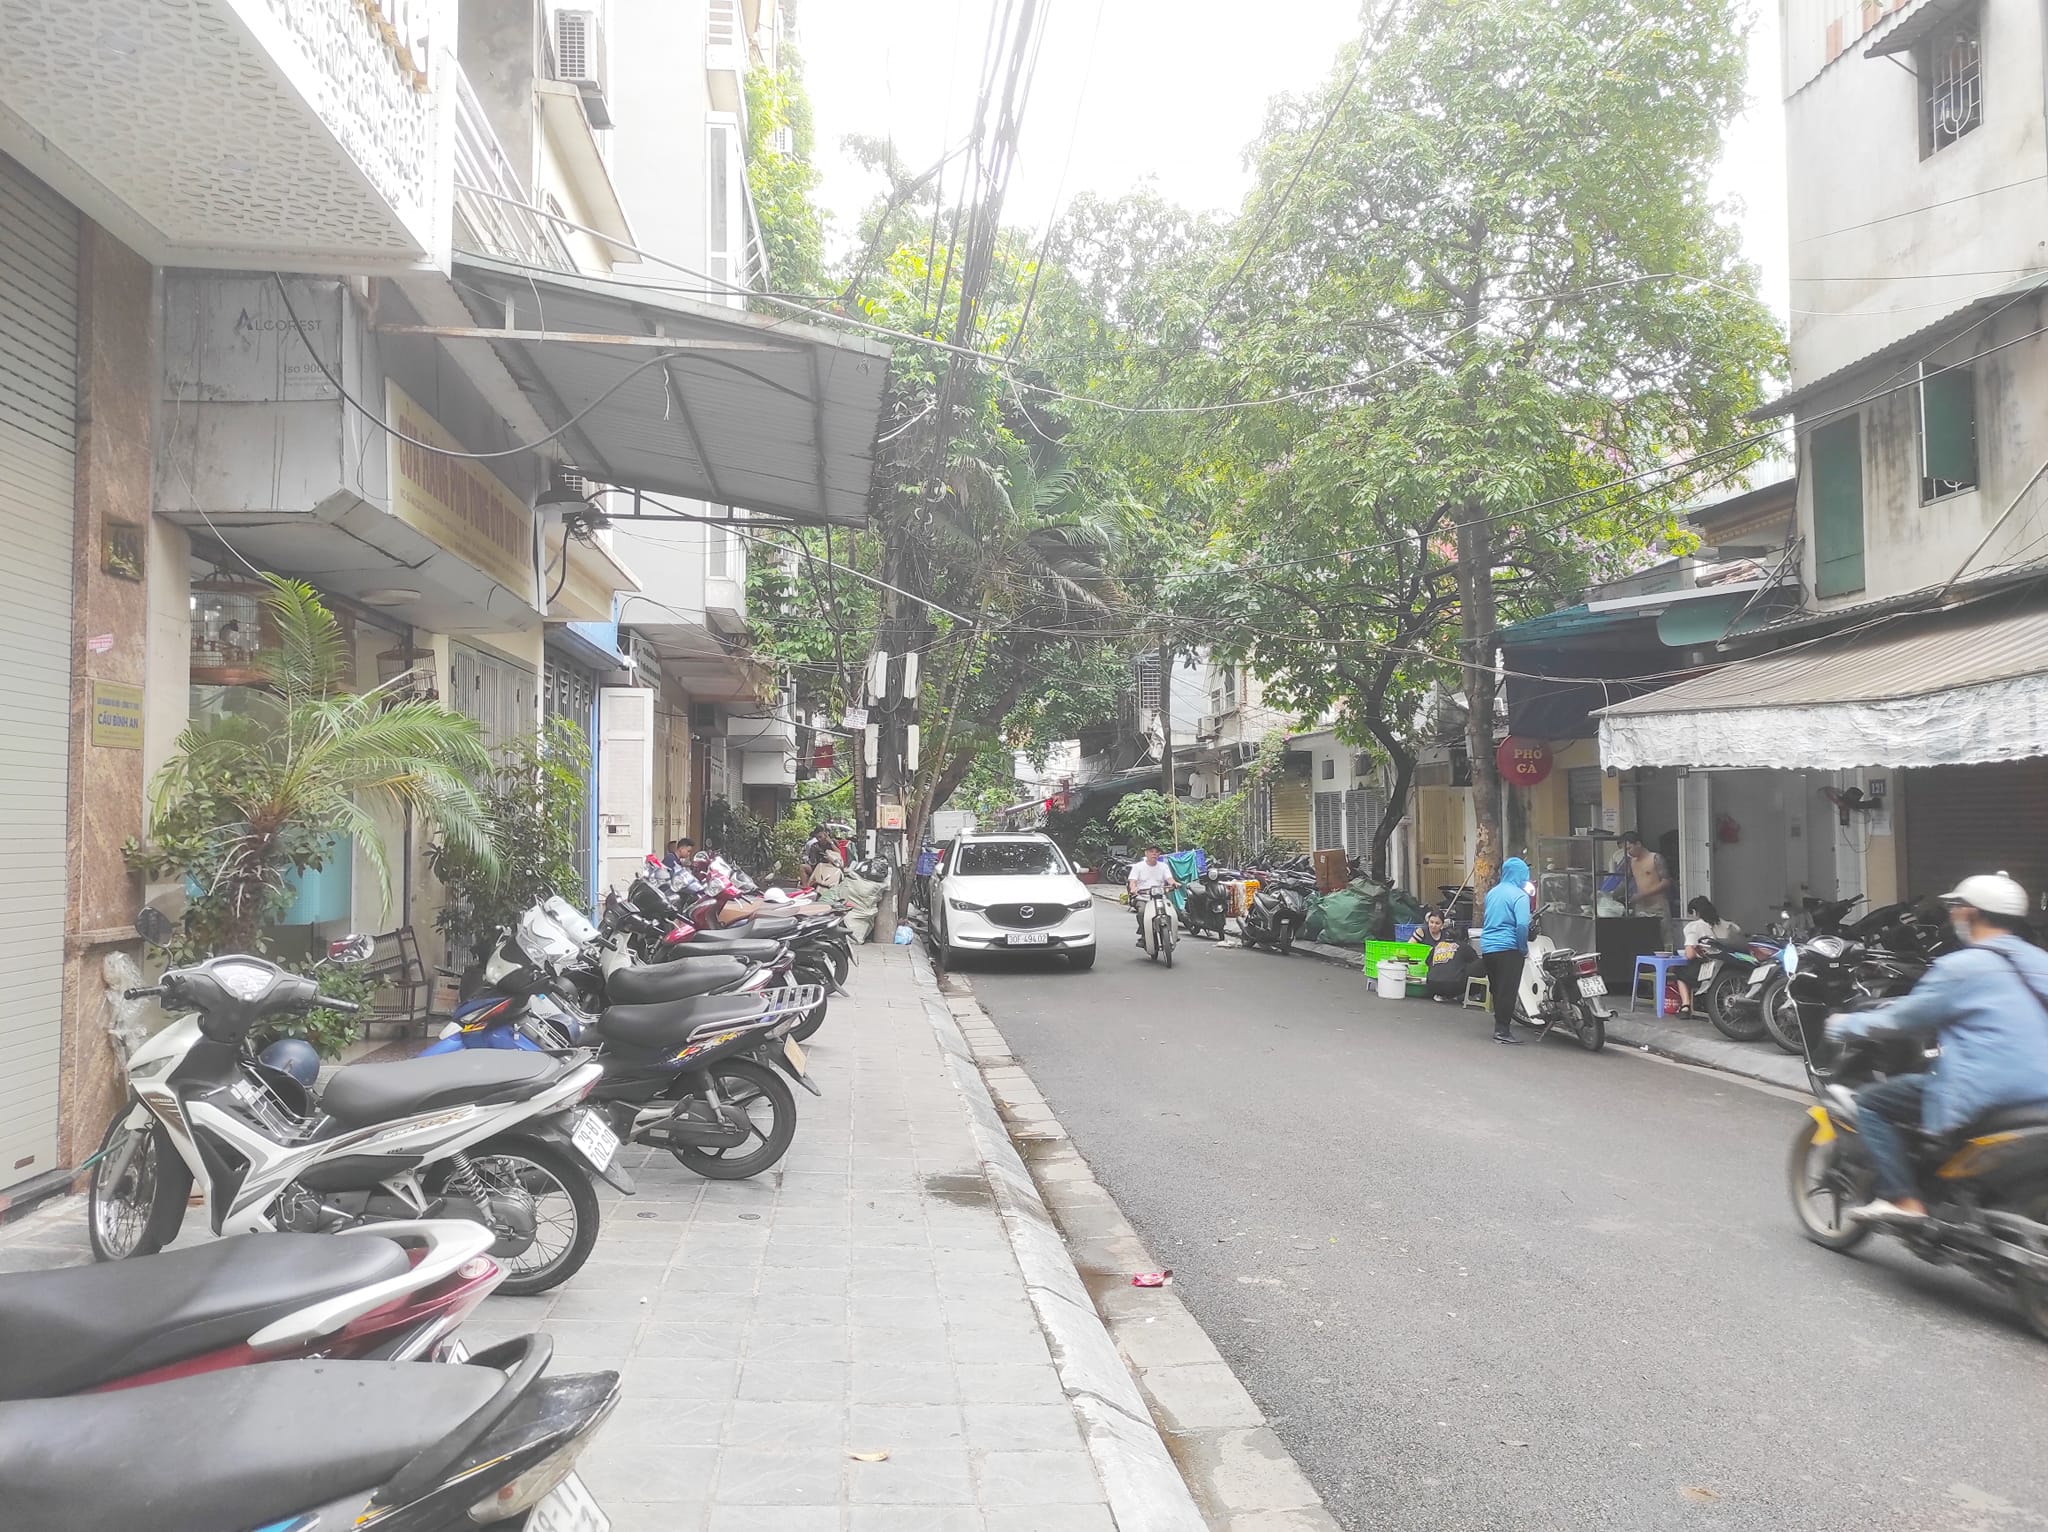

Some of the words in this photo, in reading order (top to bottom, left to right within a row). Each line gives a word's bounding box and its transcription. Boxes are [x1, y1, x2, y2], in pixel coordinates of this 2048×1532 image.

[1514, 744, 1543, 759] PHỞ
[1516, 760, 1537, 774] GÀ
[590, 1129, 617, 1169] 702.90
